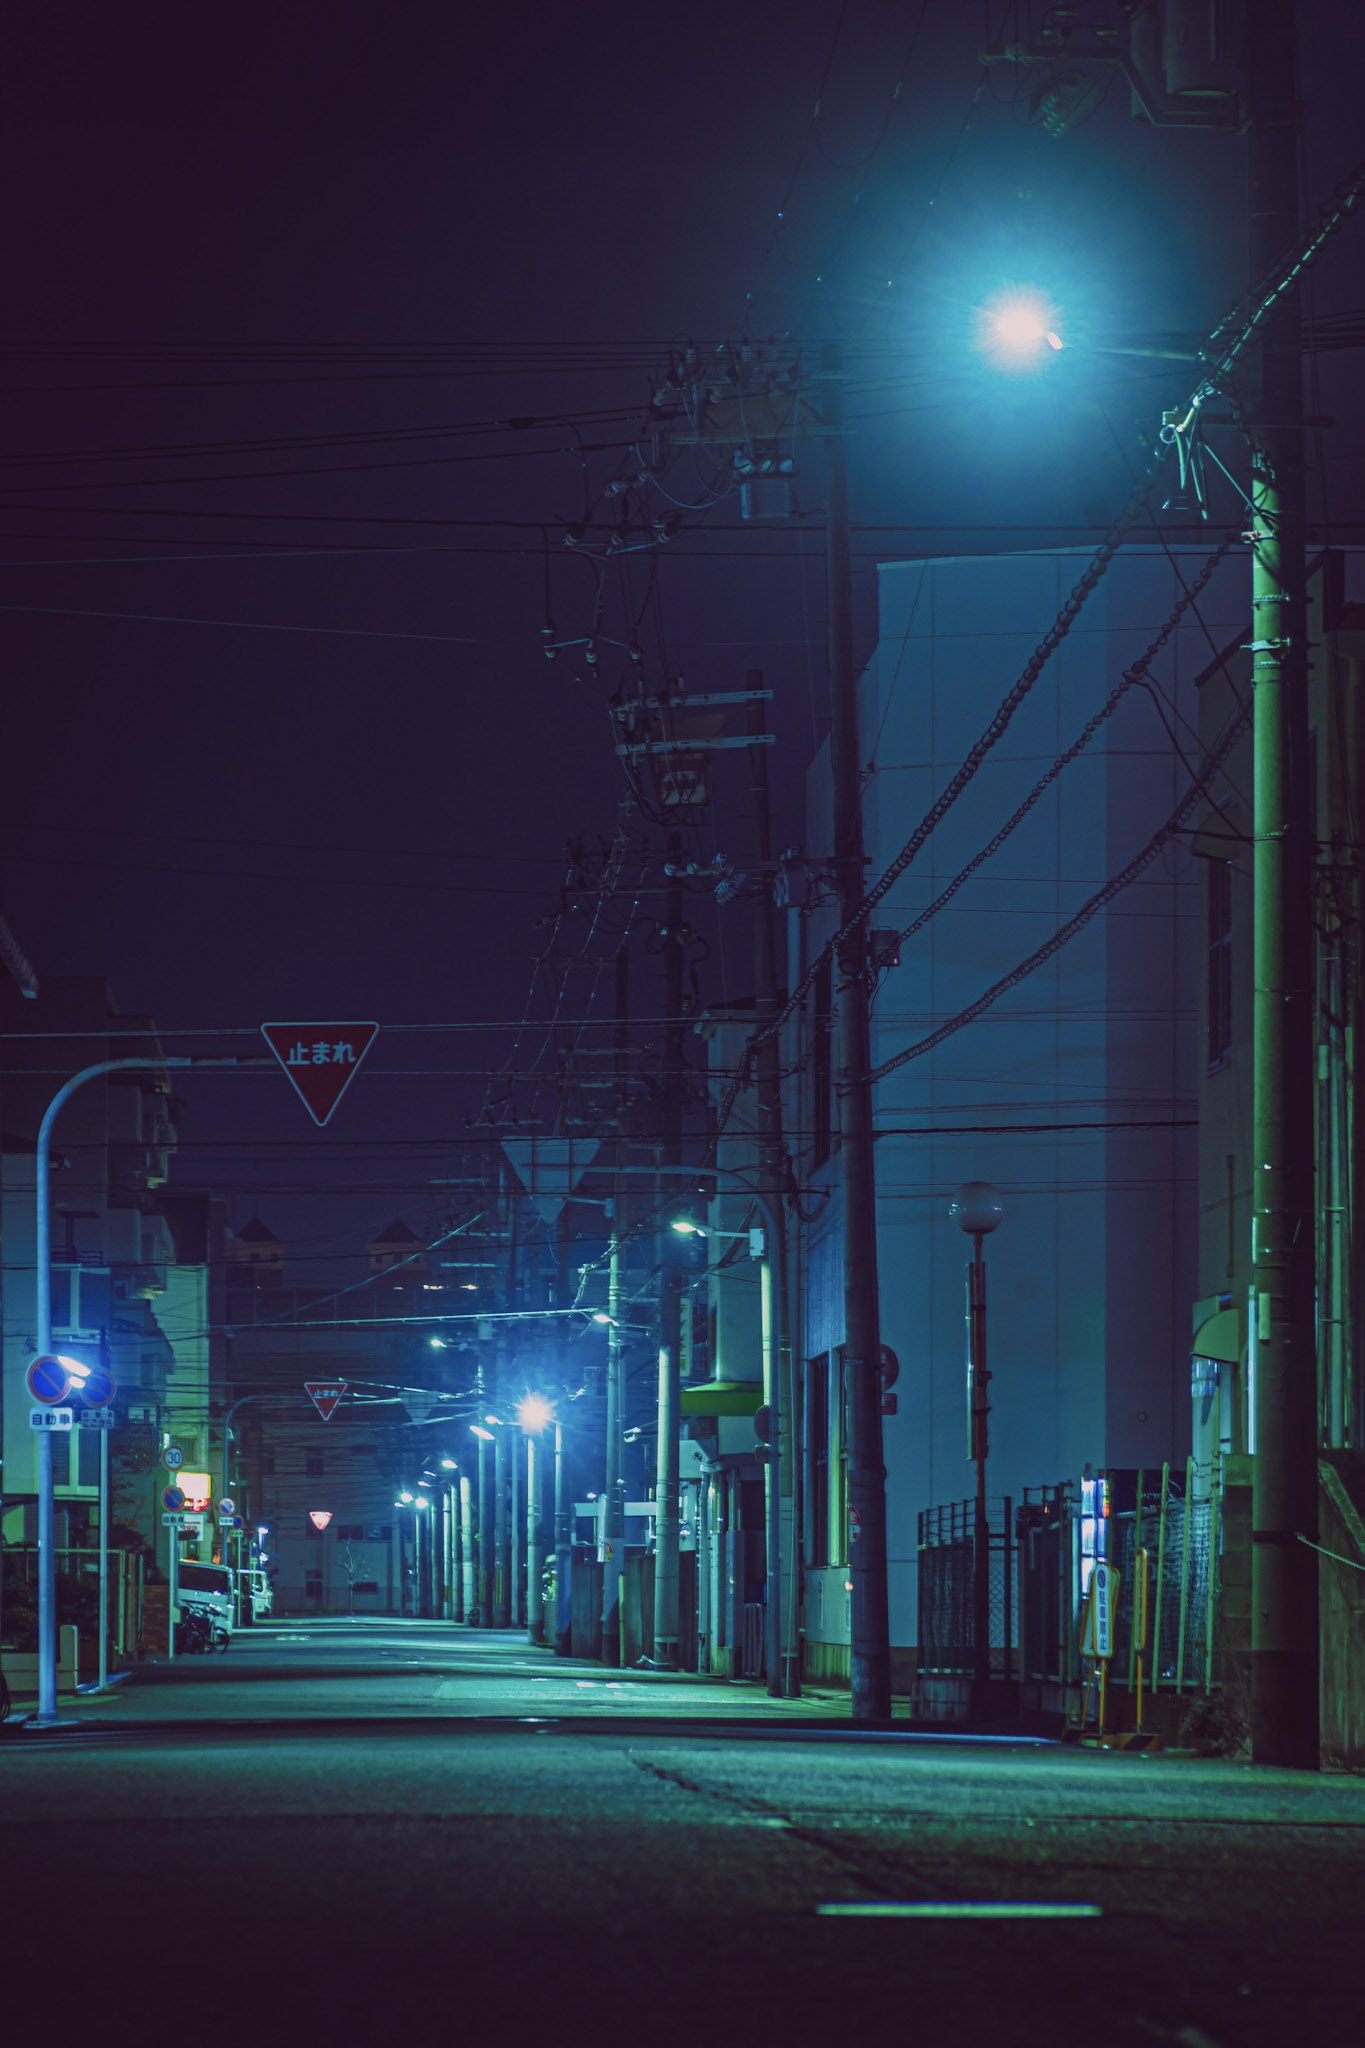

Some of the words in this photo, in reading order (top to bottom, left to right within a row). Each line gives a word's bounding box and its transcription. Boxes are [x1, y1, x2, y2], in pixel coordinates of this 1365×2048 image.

[286, 1041, 356, 1065] 止まれ
[32, 1413, 71, 1426] 自動車
[167, 1452, 180, 1464] 30
